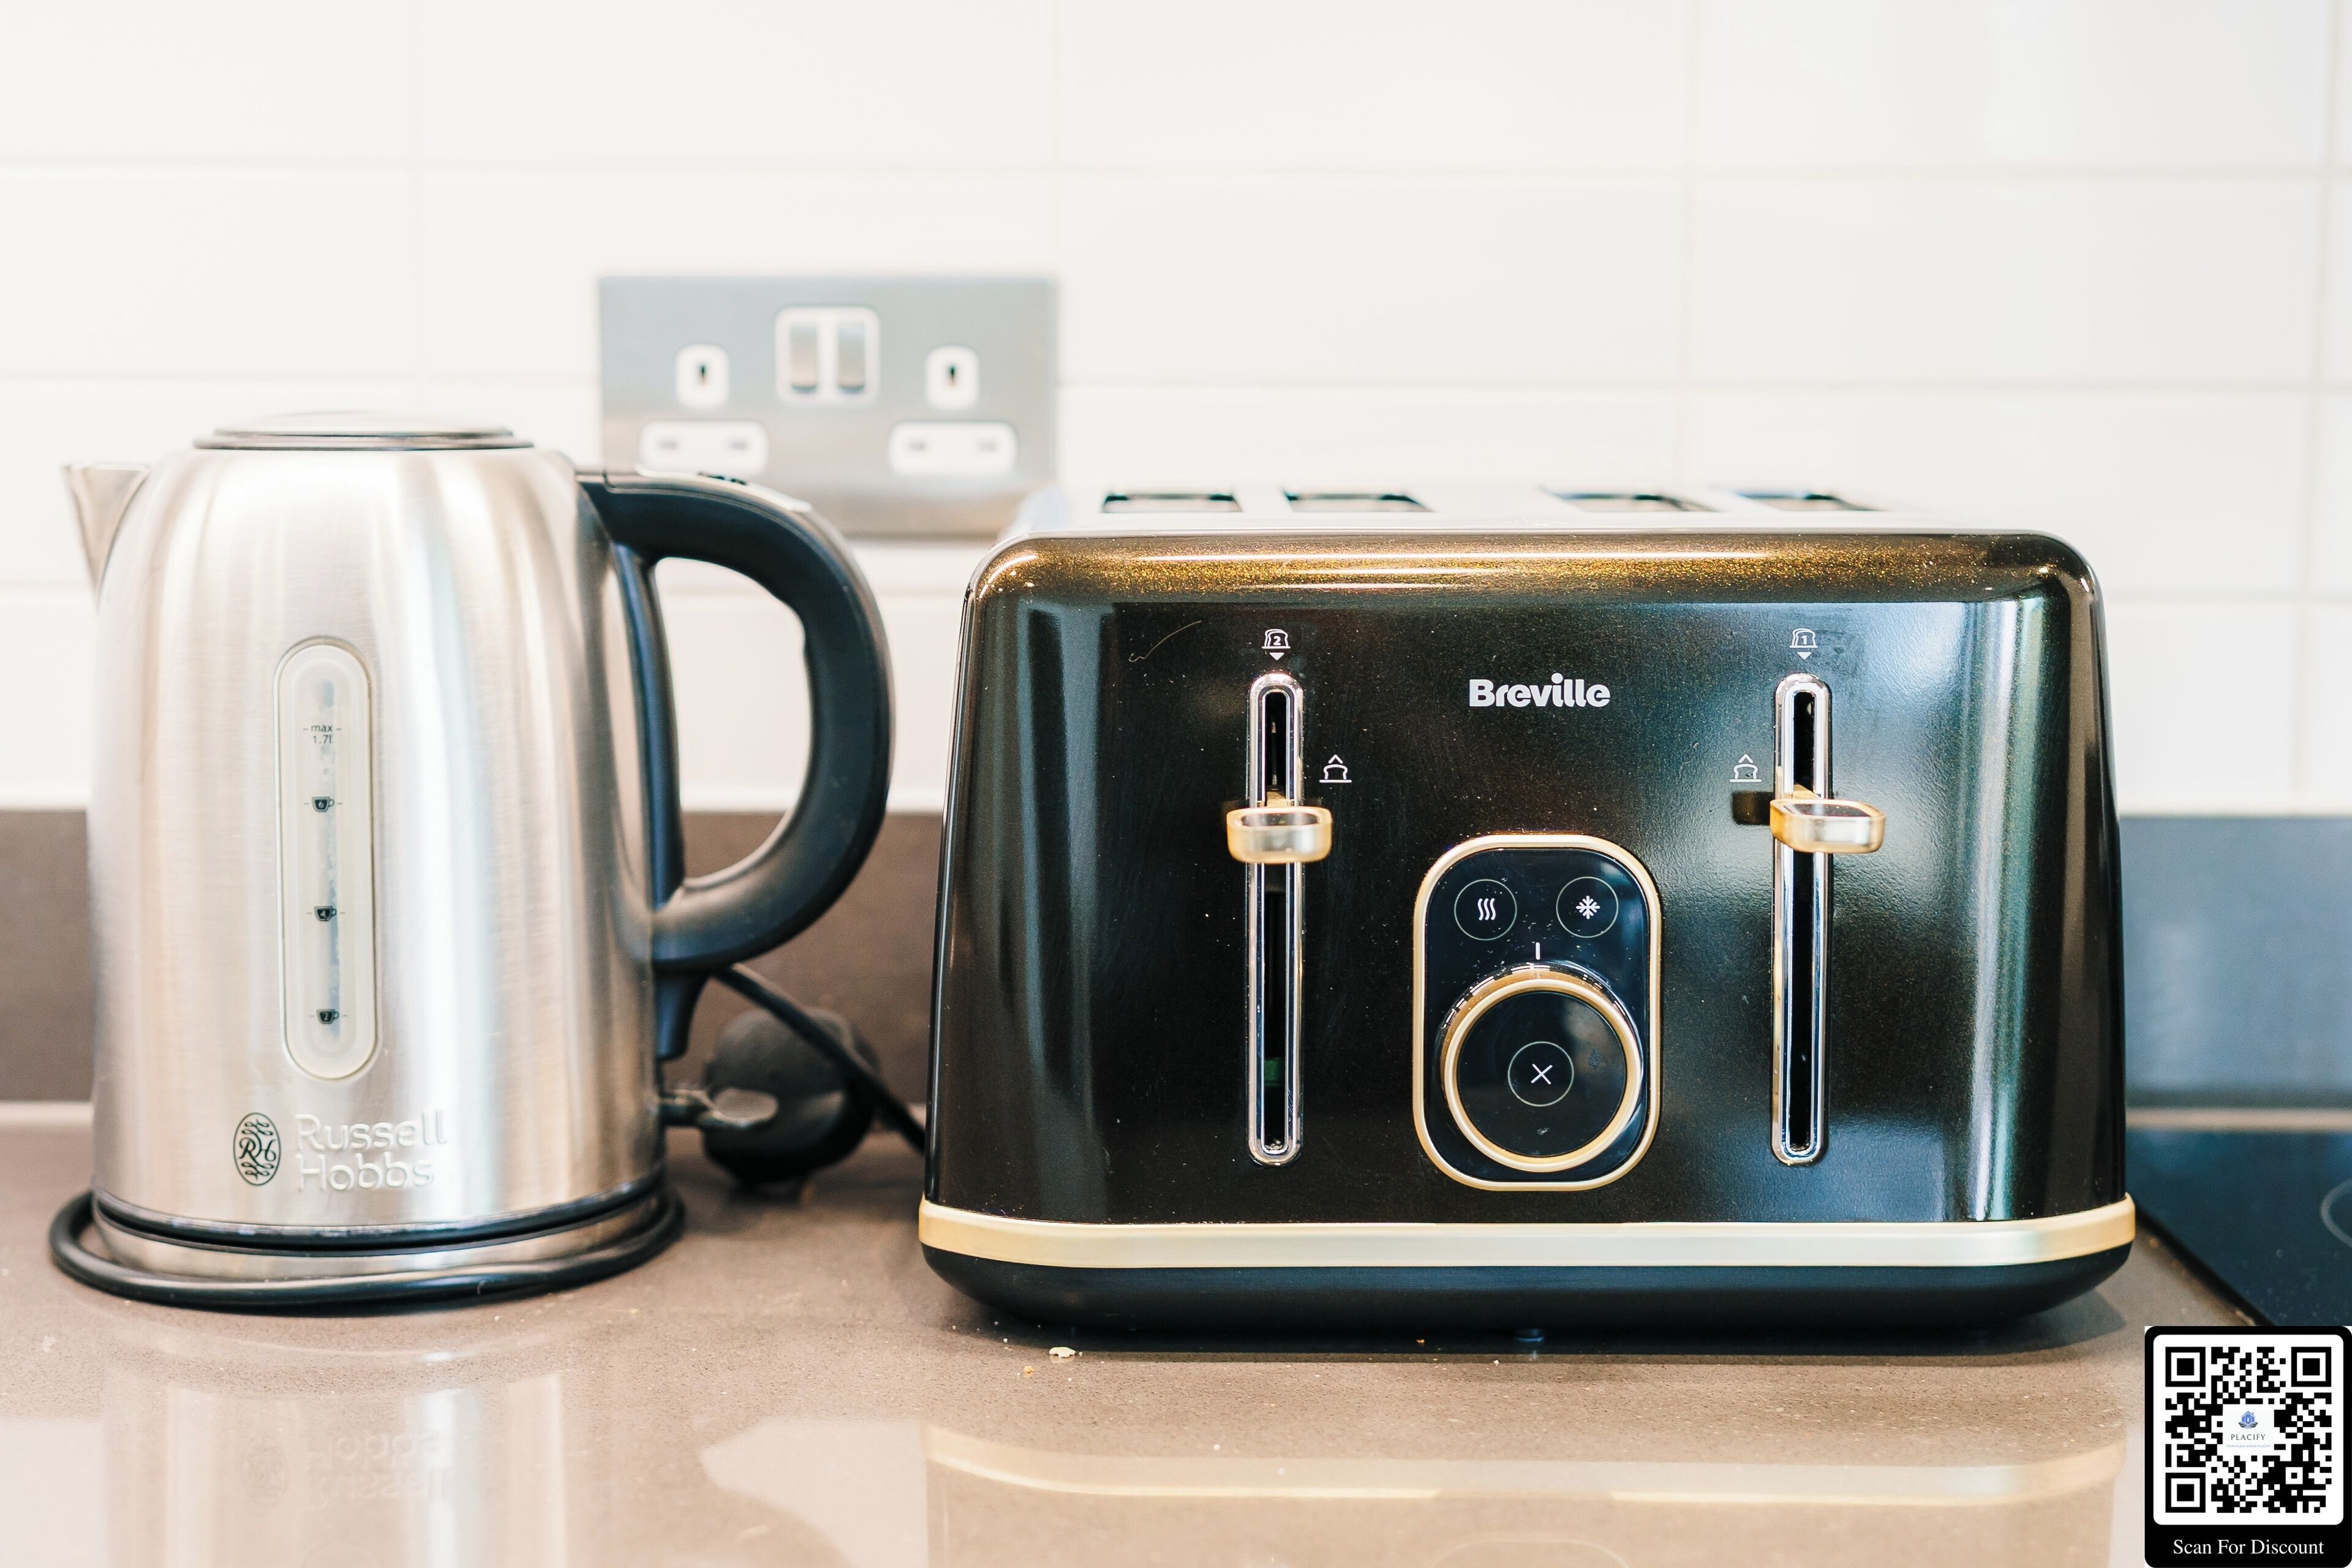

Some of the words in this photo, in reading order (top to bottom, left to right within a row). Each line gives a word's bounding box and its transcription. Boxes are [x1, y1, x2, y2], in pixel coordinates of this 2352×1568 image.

[1273, 635, 1281, 646] 2
[1801, 635, 1807, 645] 1
[1469, 672, 1611, 707] Breville
[295, 1109, 448, 1151] Russell
[295, 1152, 434, 1191] Hobbs
